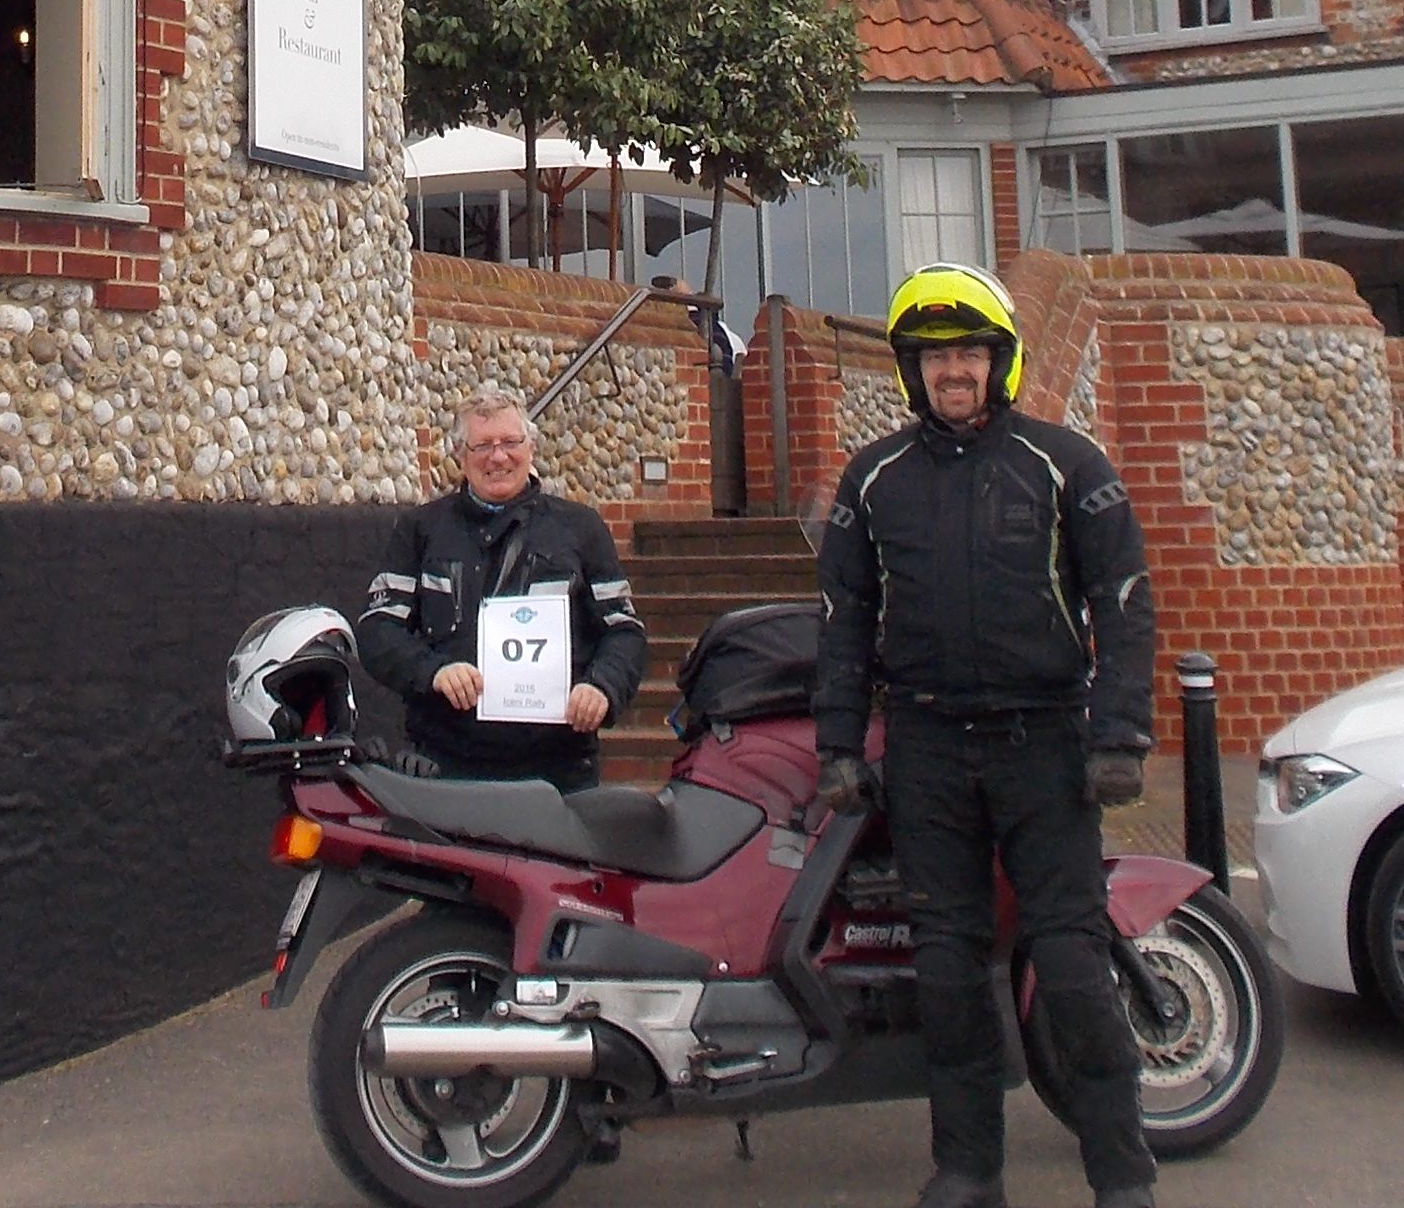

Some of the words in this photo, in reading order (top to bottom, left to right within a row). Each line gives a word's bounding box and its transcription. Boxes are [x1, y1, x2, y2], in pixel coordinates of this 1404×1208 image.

[304, 8, 317, 29] &
[279, 26, 341, 65] Restaurant
[501, 638, 548, 663] 07
[844, 924, 892, 946] Castrol
